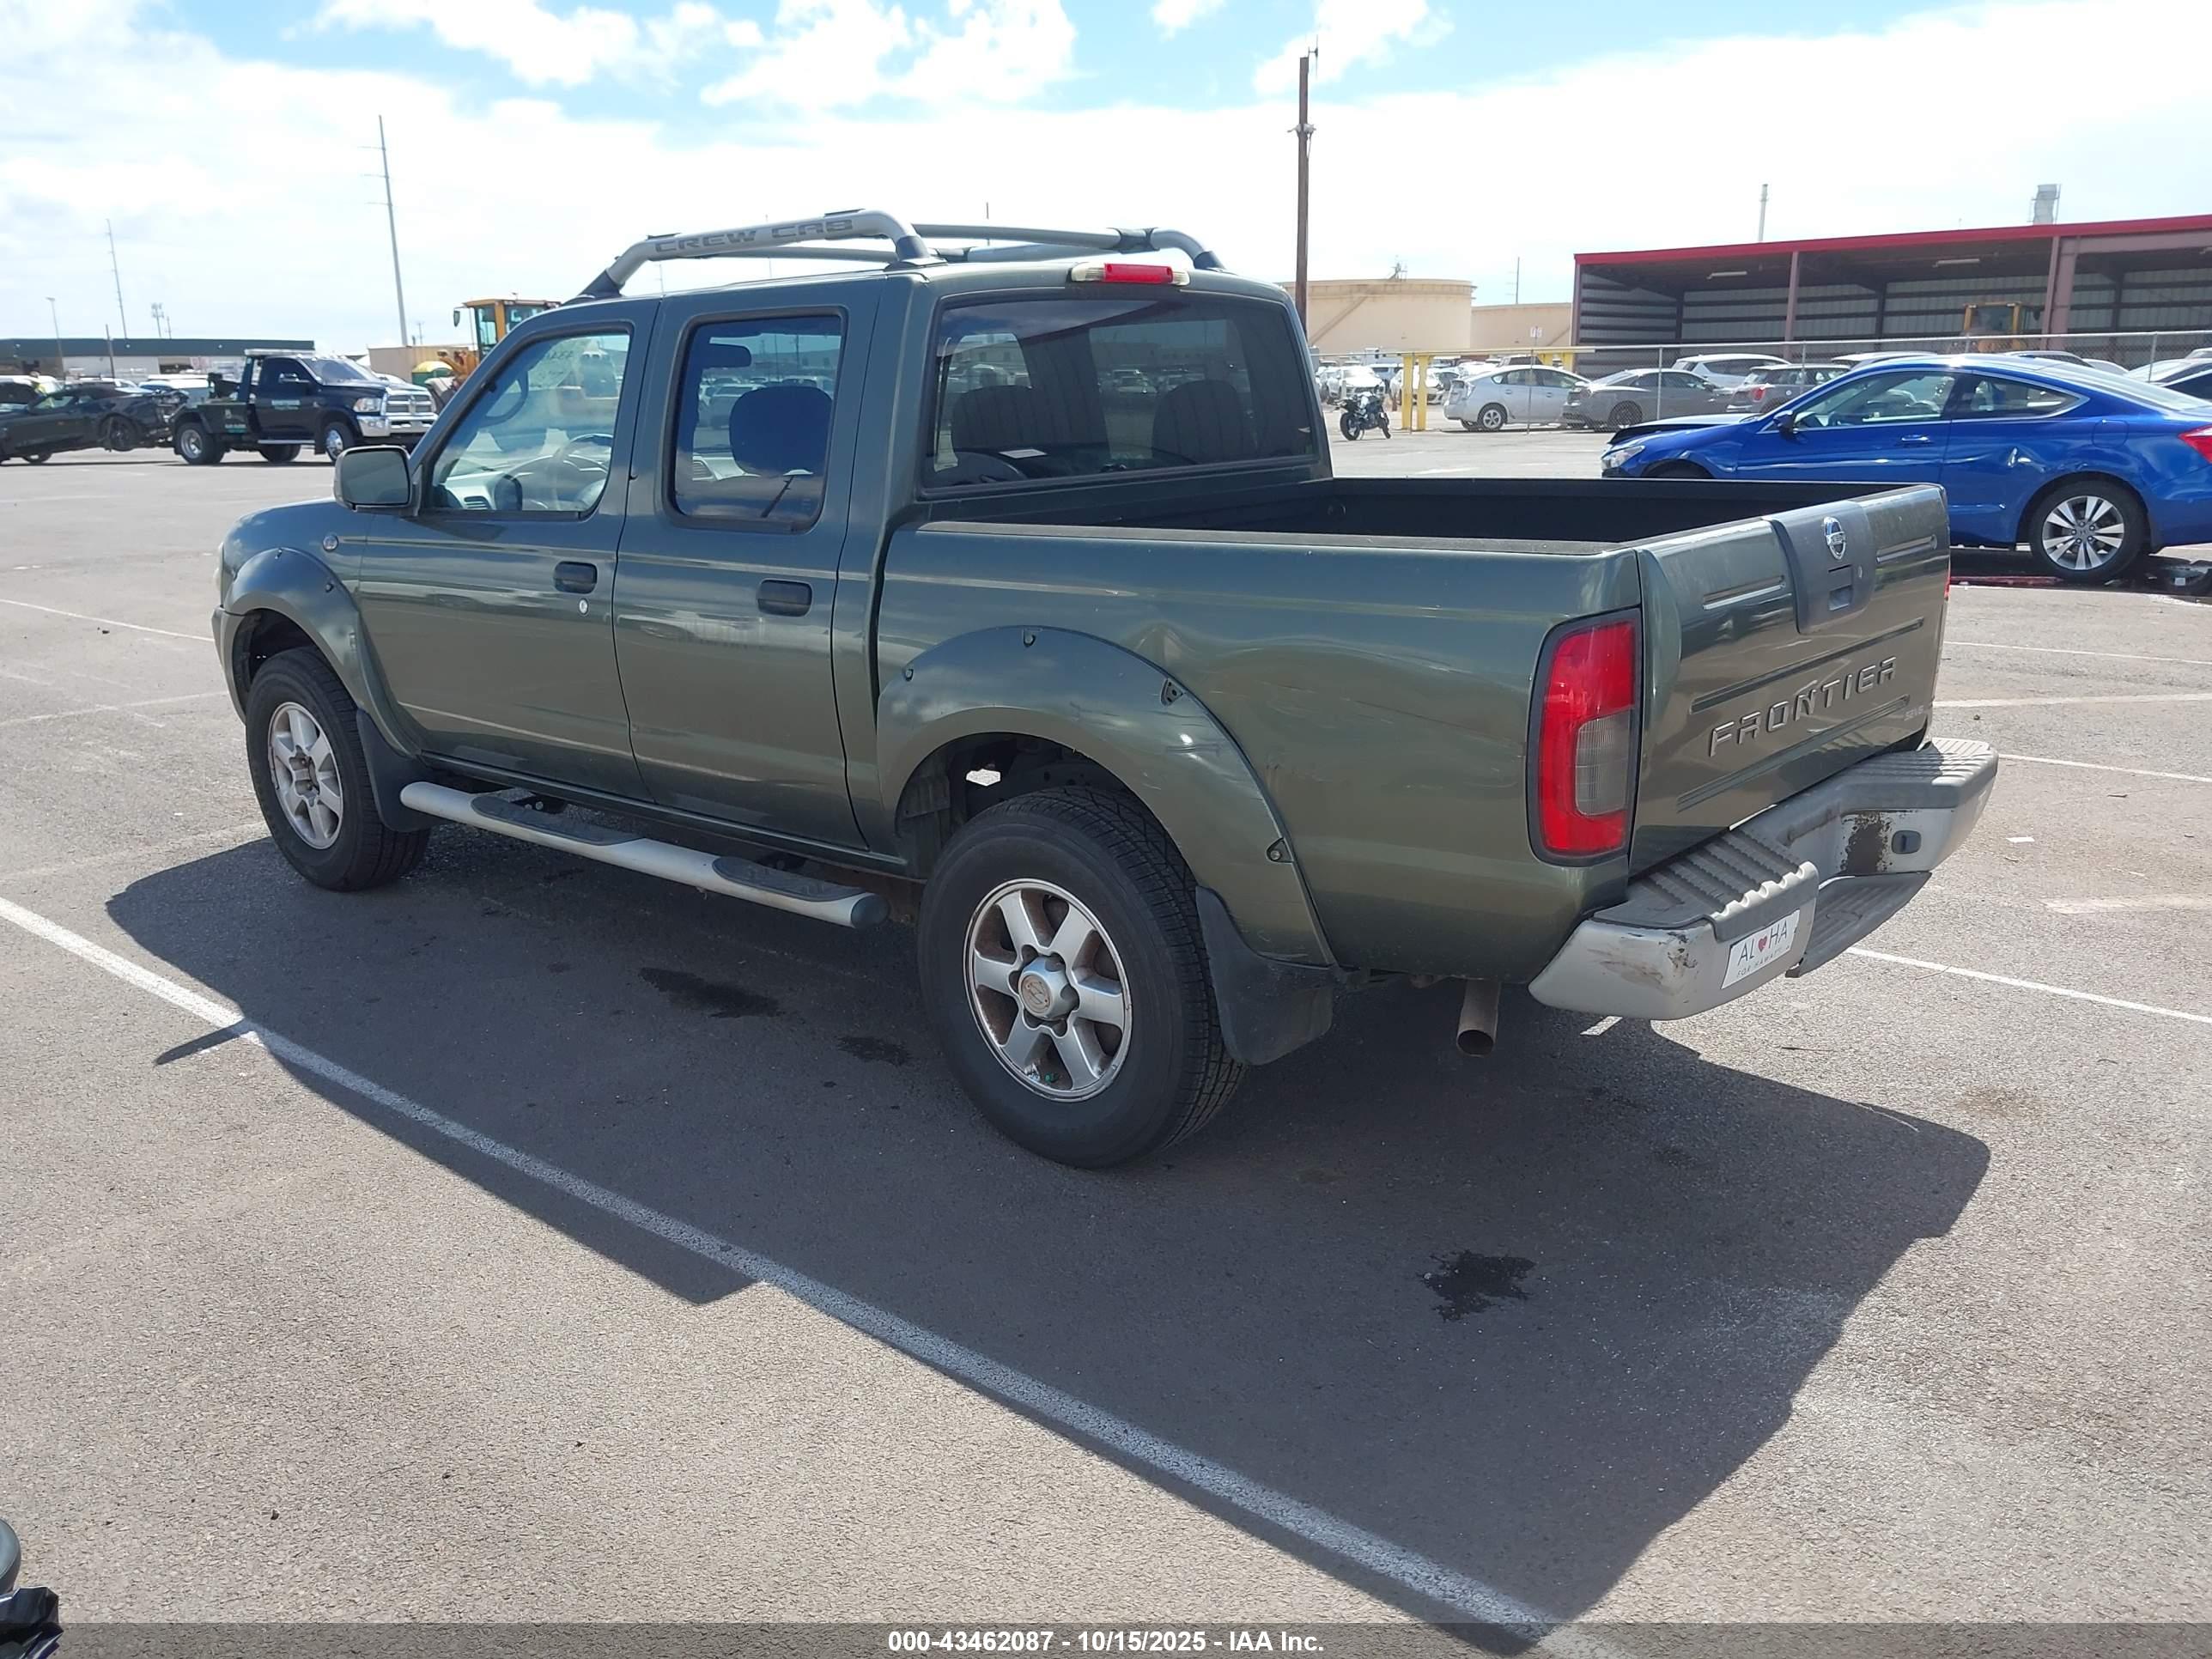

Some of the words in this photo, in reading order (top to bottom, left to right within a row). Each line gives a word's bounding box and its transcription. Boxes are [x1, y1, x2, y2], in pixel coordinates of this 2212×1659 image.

[655, 230, 757, 252] CREW
[772, 220, 854, 239] CAB
[1710, 656, 1898, 758] FRONTIER
